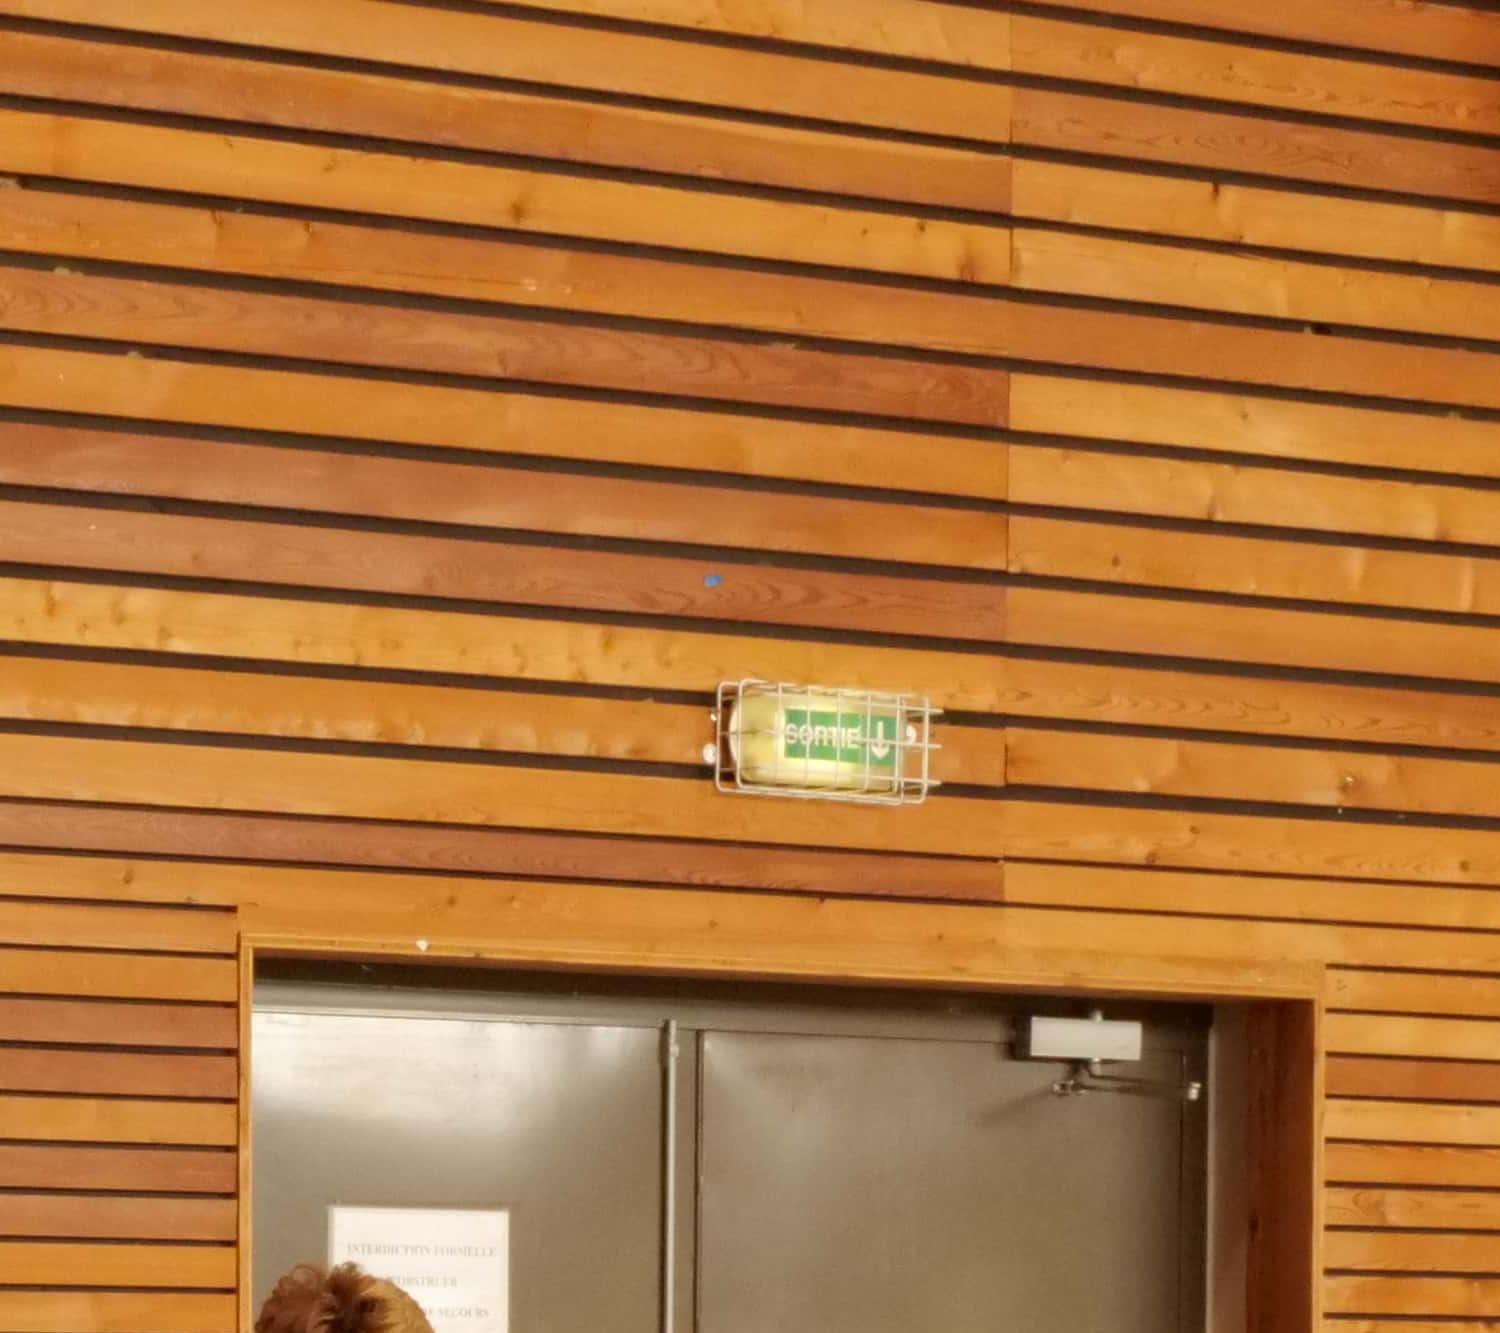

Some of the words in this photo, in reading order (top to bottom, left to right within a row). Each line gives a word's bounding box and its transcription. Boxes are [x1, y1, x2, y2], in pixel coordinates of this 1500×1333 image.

[786, 724, 860, 749] SORTIE
[347, 1243, 431, 1256] INTERDICTION
[434, 1245, 496, 1257] FORMELLE
[438, 1306, 489, 1318] SECOURS
